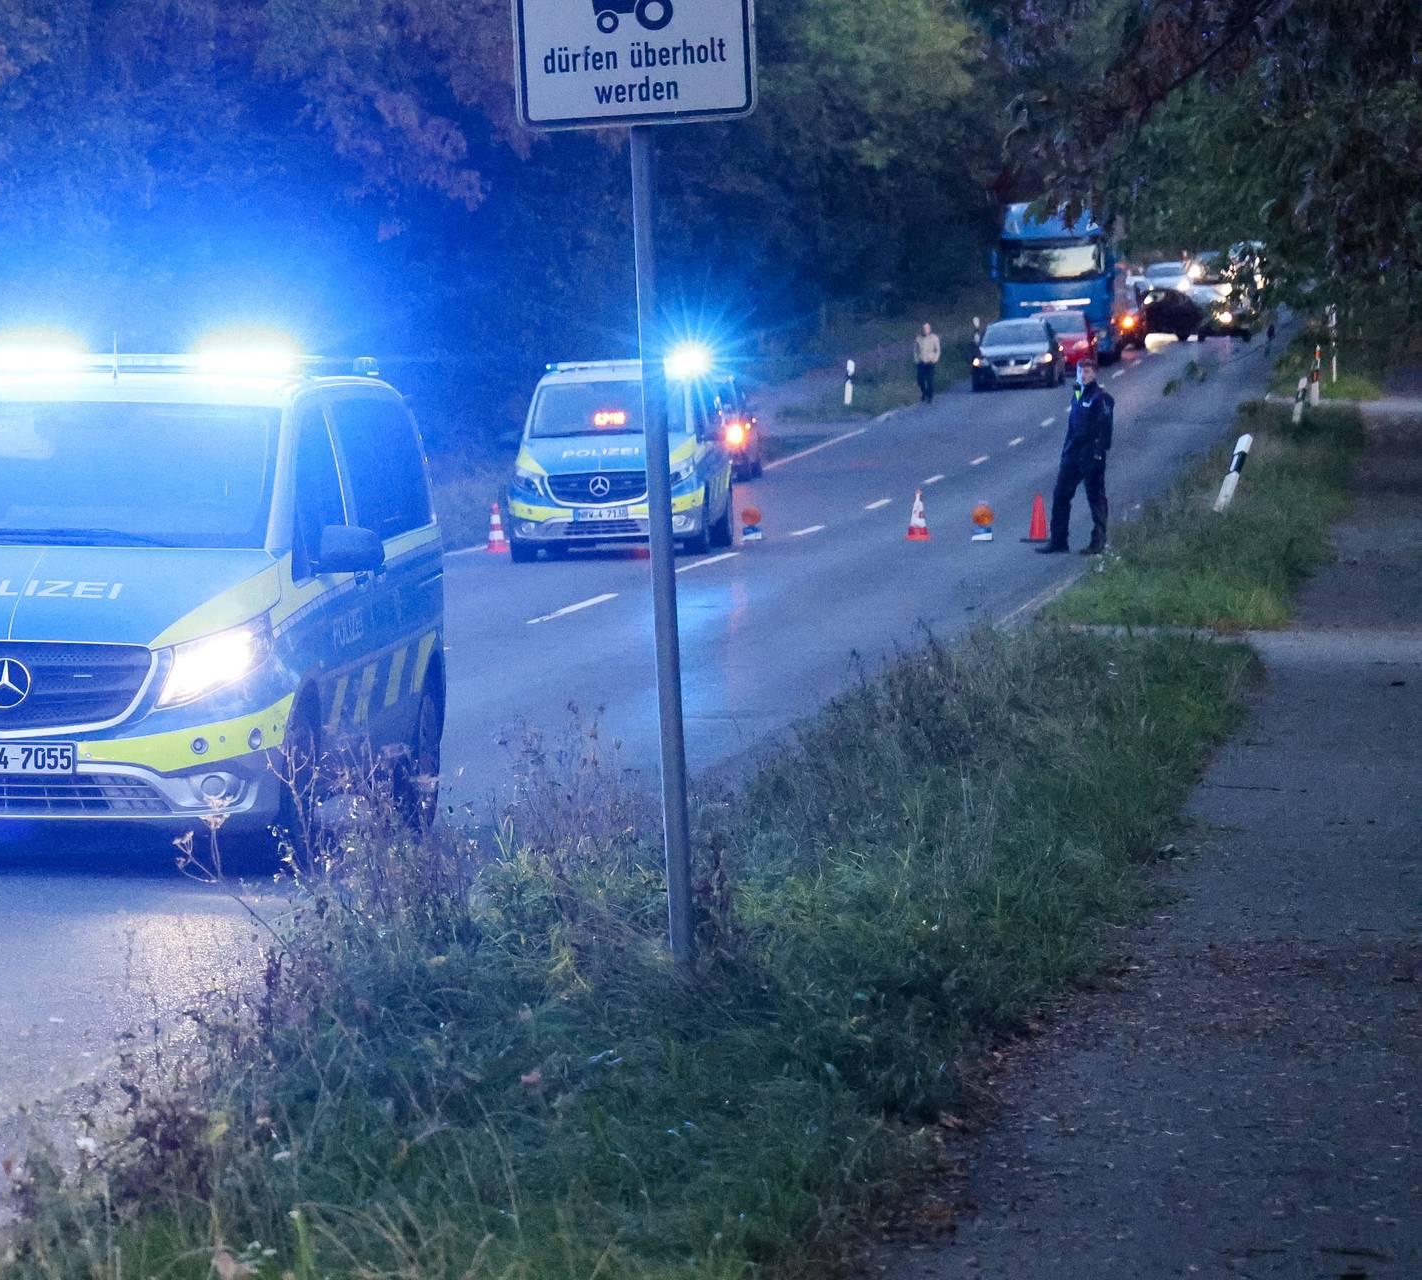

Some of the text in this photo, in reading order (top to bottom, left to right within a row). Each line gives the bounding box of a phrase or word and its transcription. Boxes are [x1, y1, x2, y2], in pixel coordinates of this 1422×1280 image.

[543, 37, 727, 74] dürfen überholt
[594, 76, 679, 104] werden
[562, 447, 640, 458] POLIZEI
